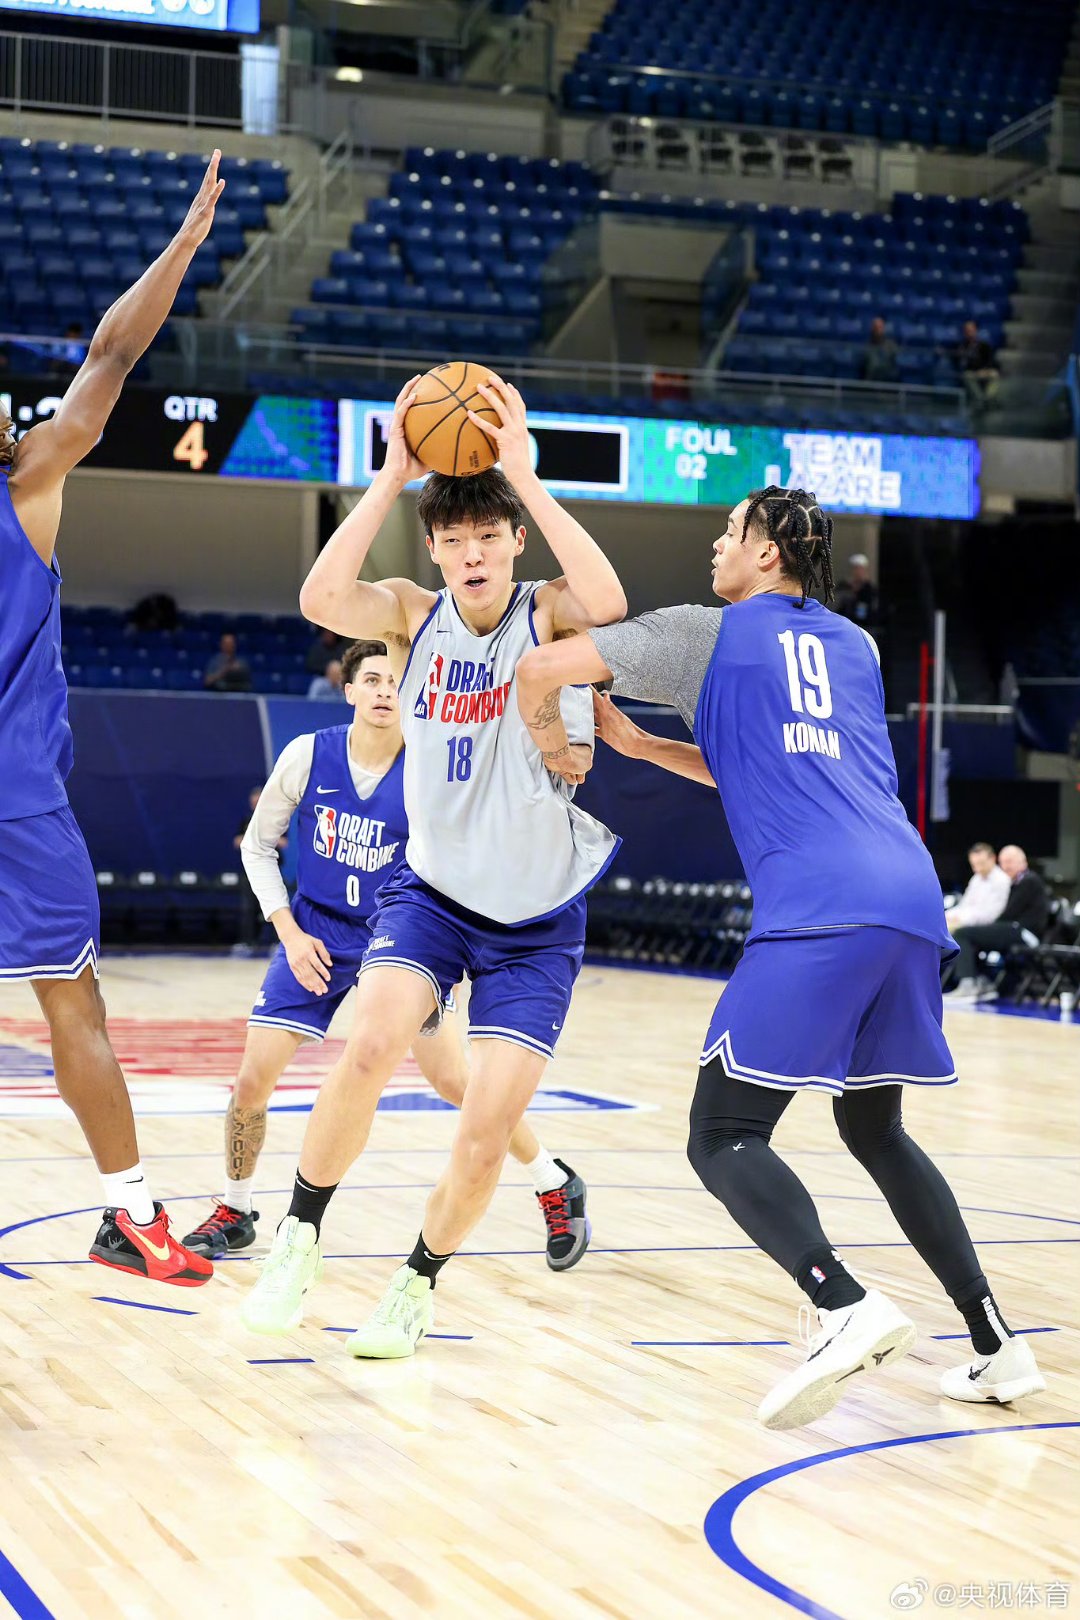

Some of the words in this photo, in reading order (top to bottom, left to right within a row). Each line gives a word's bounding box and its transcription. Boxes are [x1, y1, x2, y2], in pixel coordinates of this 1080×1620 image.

[164, 396, 218, 421] QTR
[173, 421, 208, 470] 4
[665, 426, 738, 456] FOUL
[783, 433, 882, 466] TEAM
[675, 453, 707, 480] 02
[777, 629, 833, 719] 19
[782, 721, 842, 760] KONAN
[447, 736, 473, 782] 18
[338, 812, 386, 847] DRAFT
[336, 837, 400, 873] COMBINE
[346, 874, 360, 907] 0
